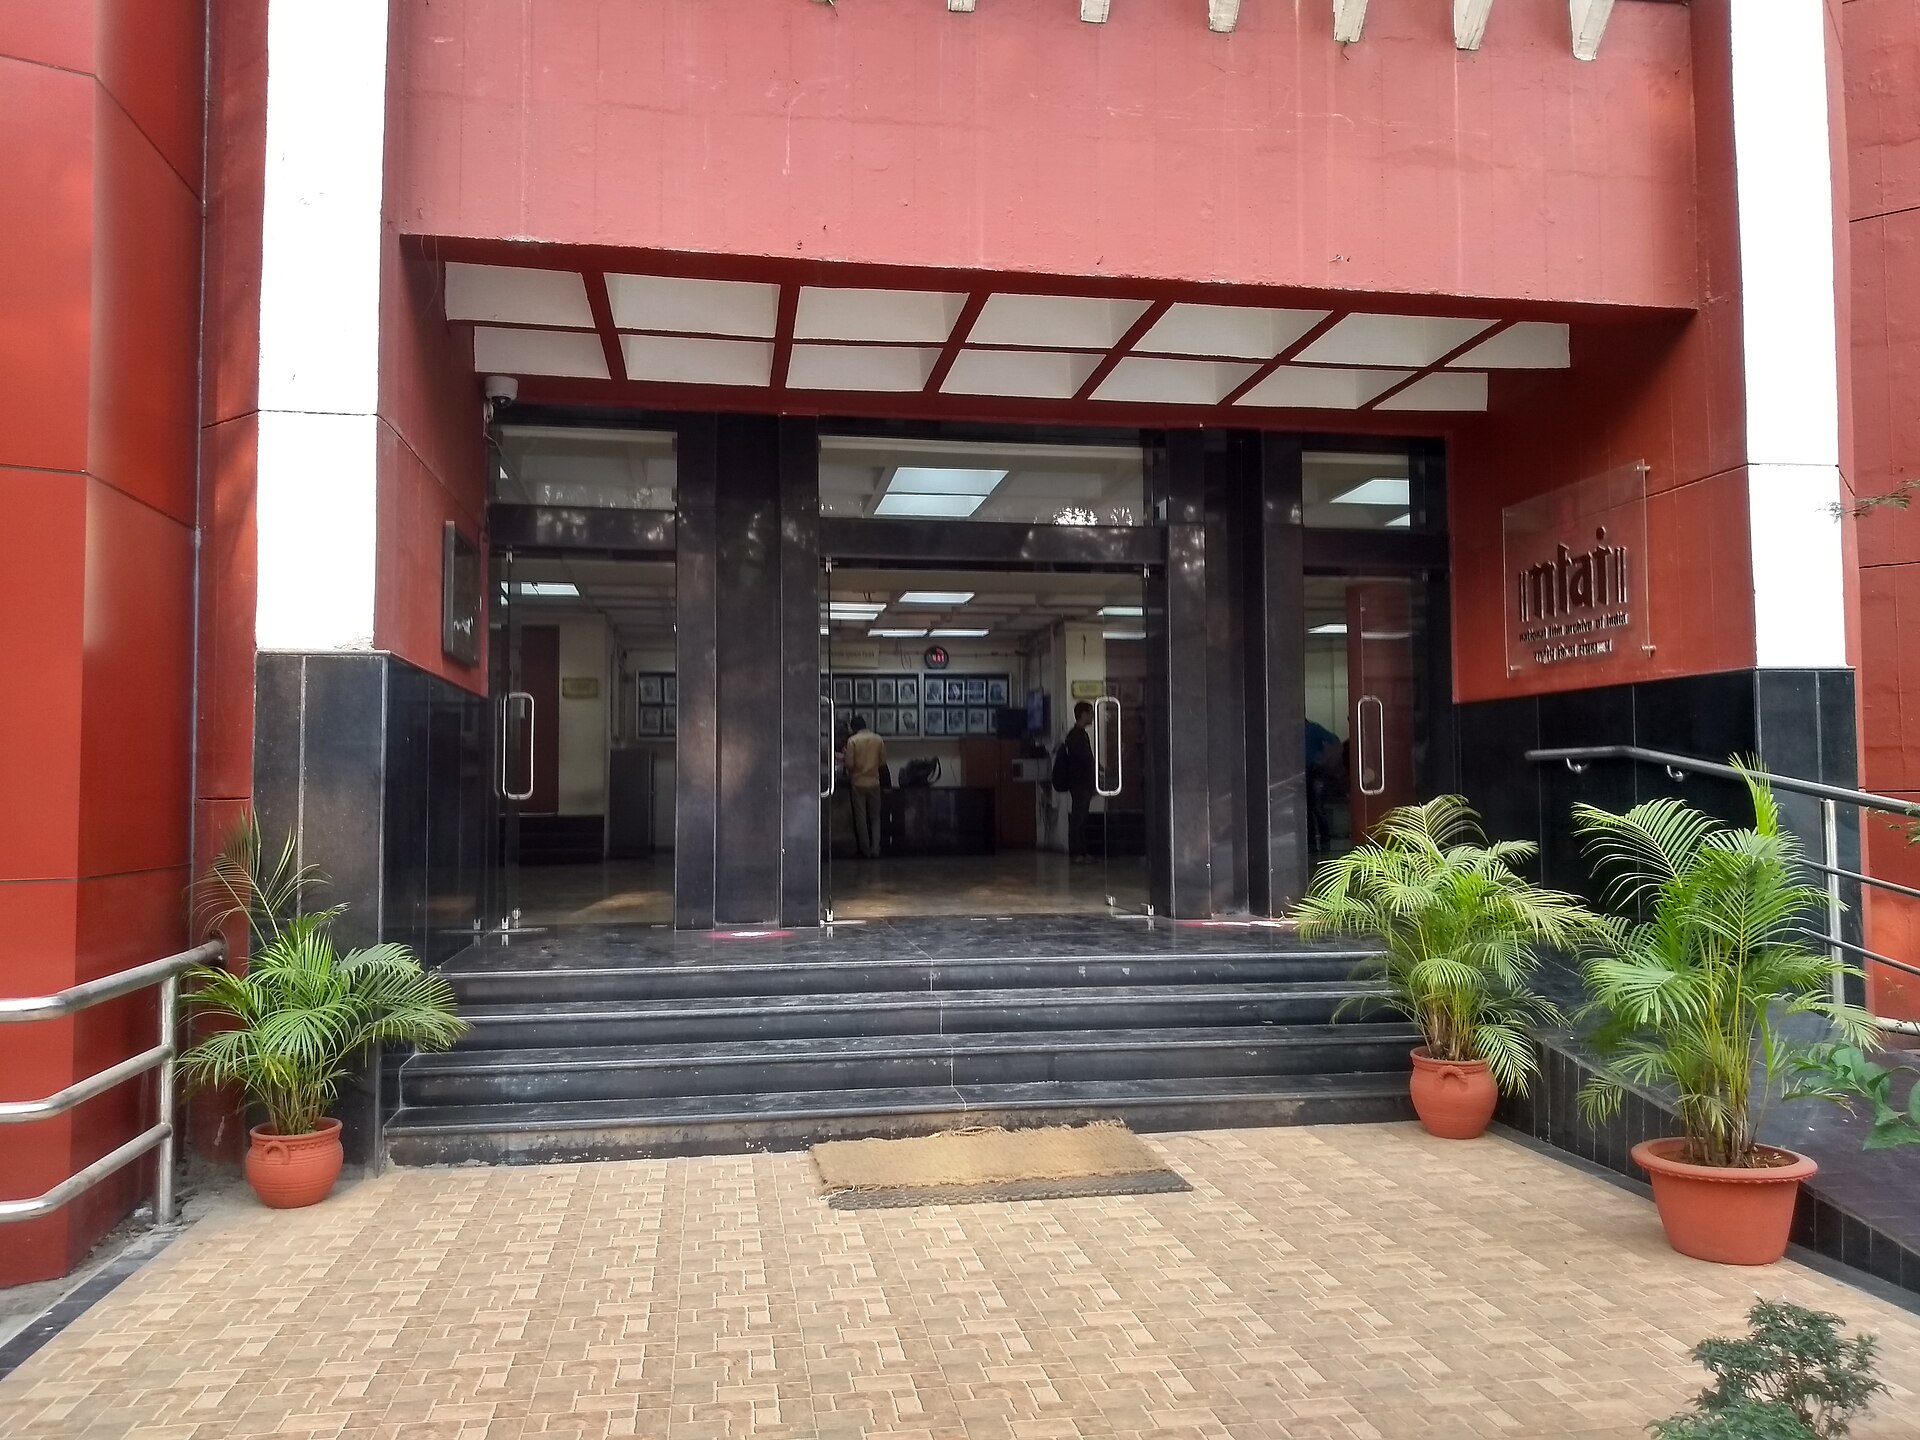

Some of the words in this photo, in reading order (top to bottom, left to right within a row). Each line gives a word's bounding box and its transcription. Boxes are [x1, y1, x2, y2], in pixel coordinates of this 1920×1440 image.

[1550, 623, 1565, 638] film
[1566, 618, 1595, 635] archive
[1596, 614, 1606, 629] of
